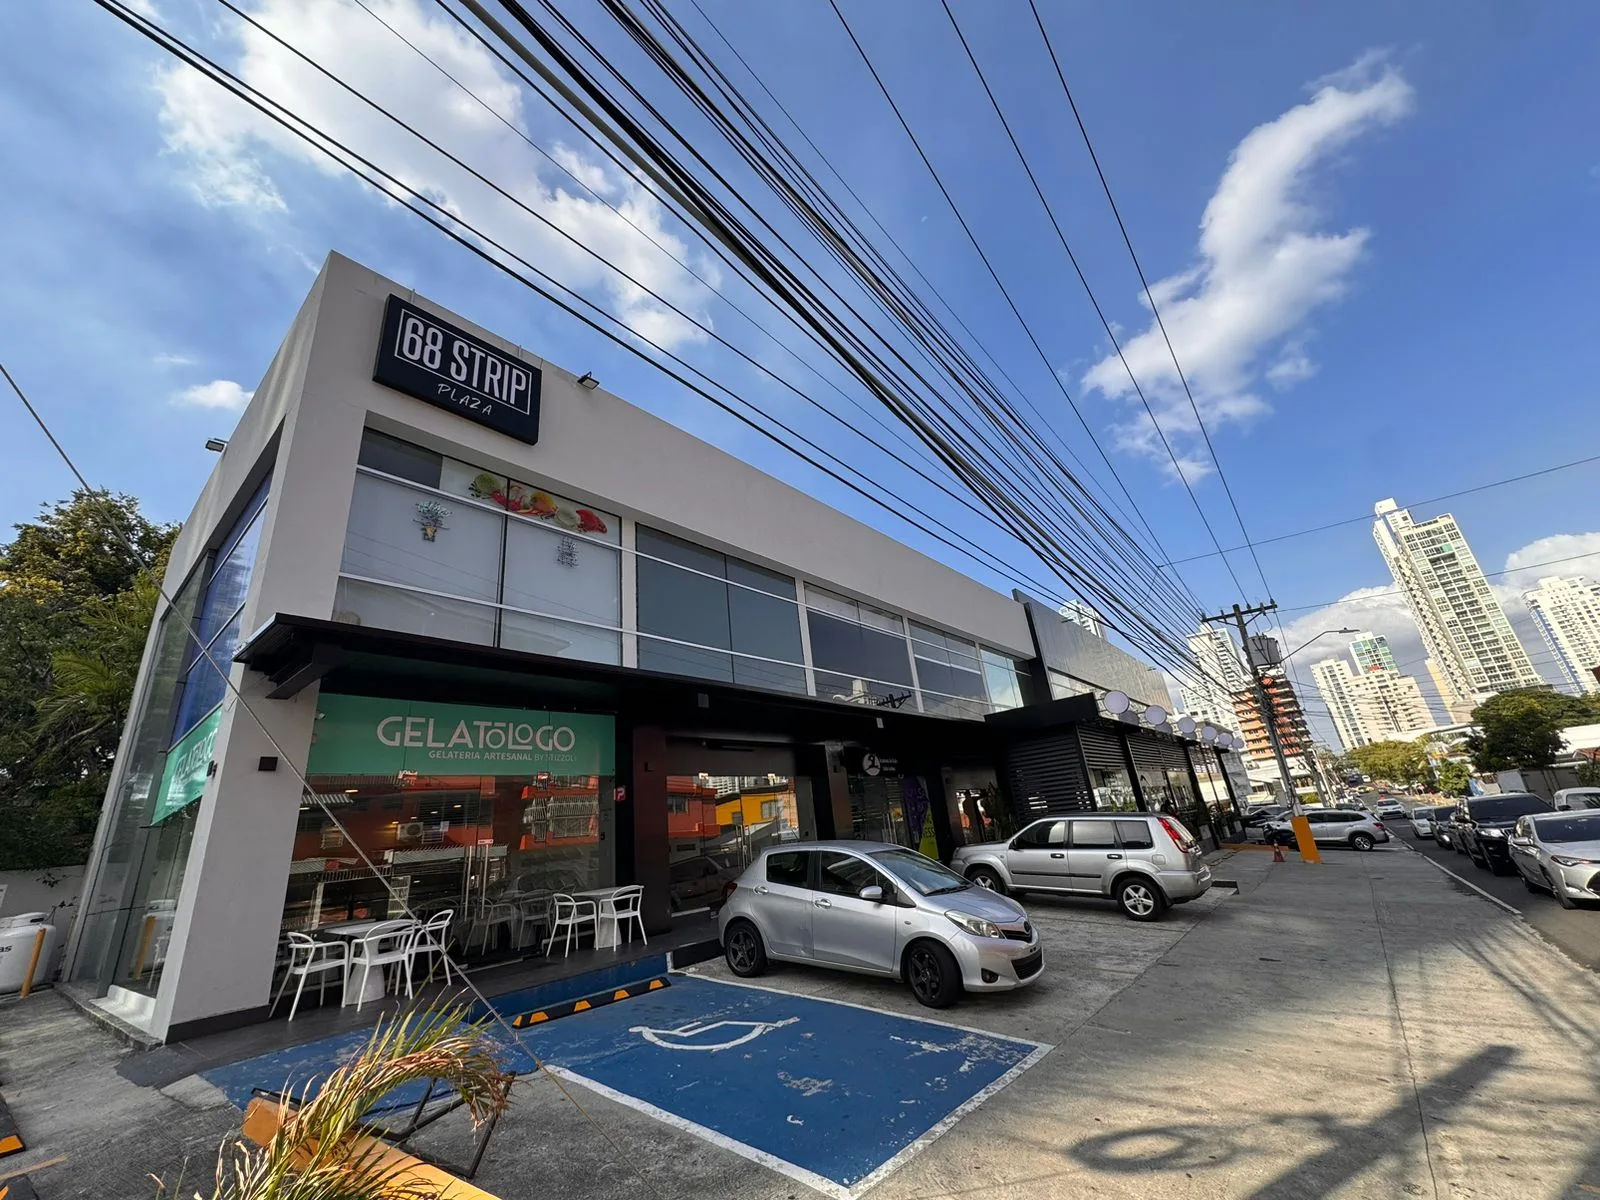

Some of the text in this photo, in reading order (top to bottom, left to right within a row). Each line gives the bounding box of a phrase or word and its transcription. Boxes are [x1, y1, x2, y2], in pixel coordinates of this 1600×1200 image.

[403, 318, 527, 405] 68 STRIP
[437, 384, 493, 415] PLAZA
[428, 750, 480, 759] GELATERIA
[483, 752, 533, 761] ARTESANAL
[534, 753, 543, 761] BY
